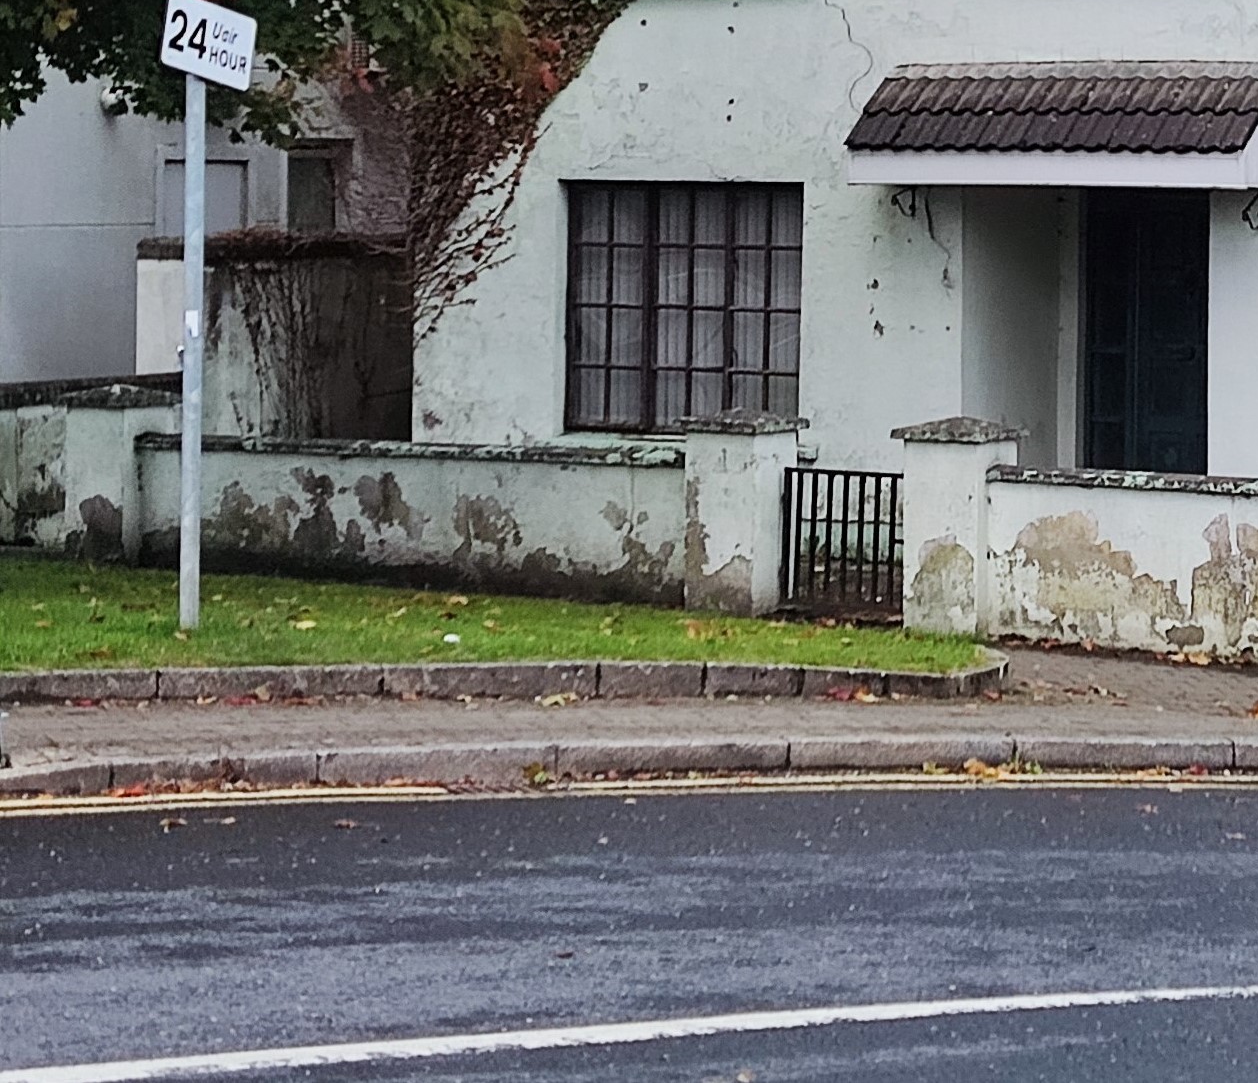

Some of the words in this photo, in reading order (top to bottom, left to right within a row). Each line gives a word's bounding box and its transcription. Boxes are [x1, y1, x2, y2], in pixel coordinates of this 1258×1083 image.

[168, 9, 207, 59] 24
[212, 21, 238, 44] Uair
[209, 45, 247, 74] HOUR
